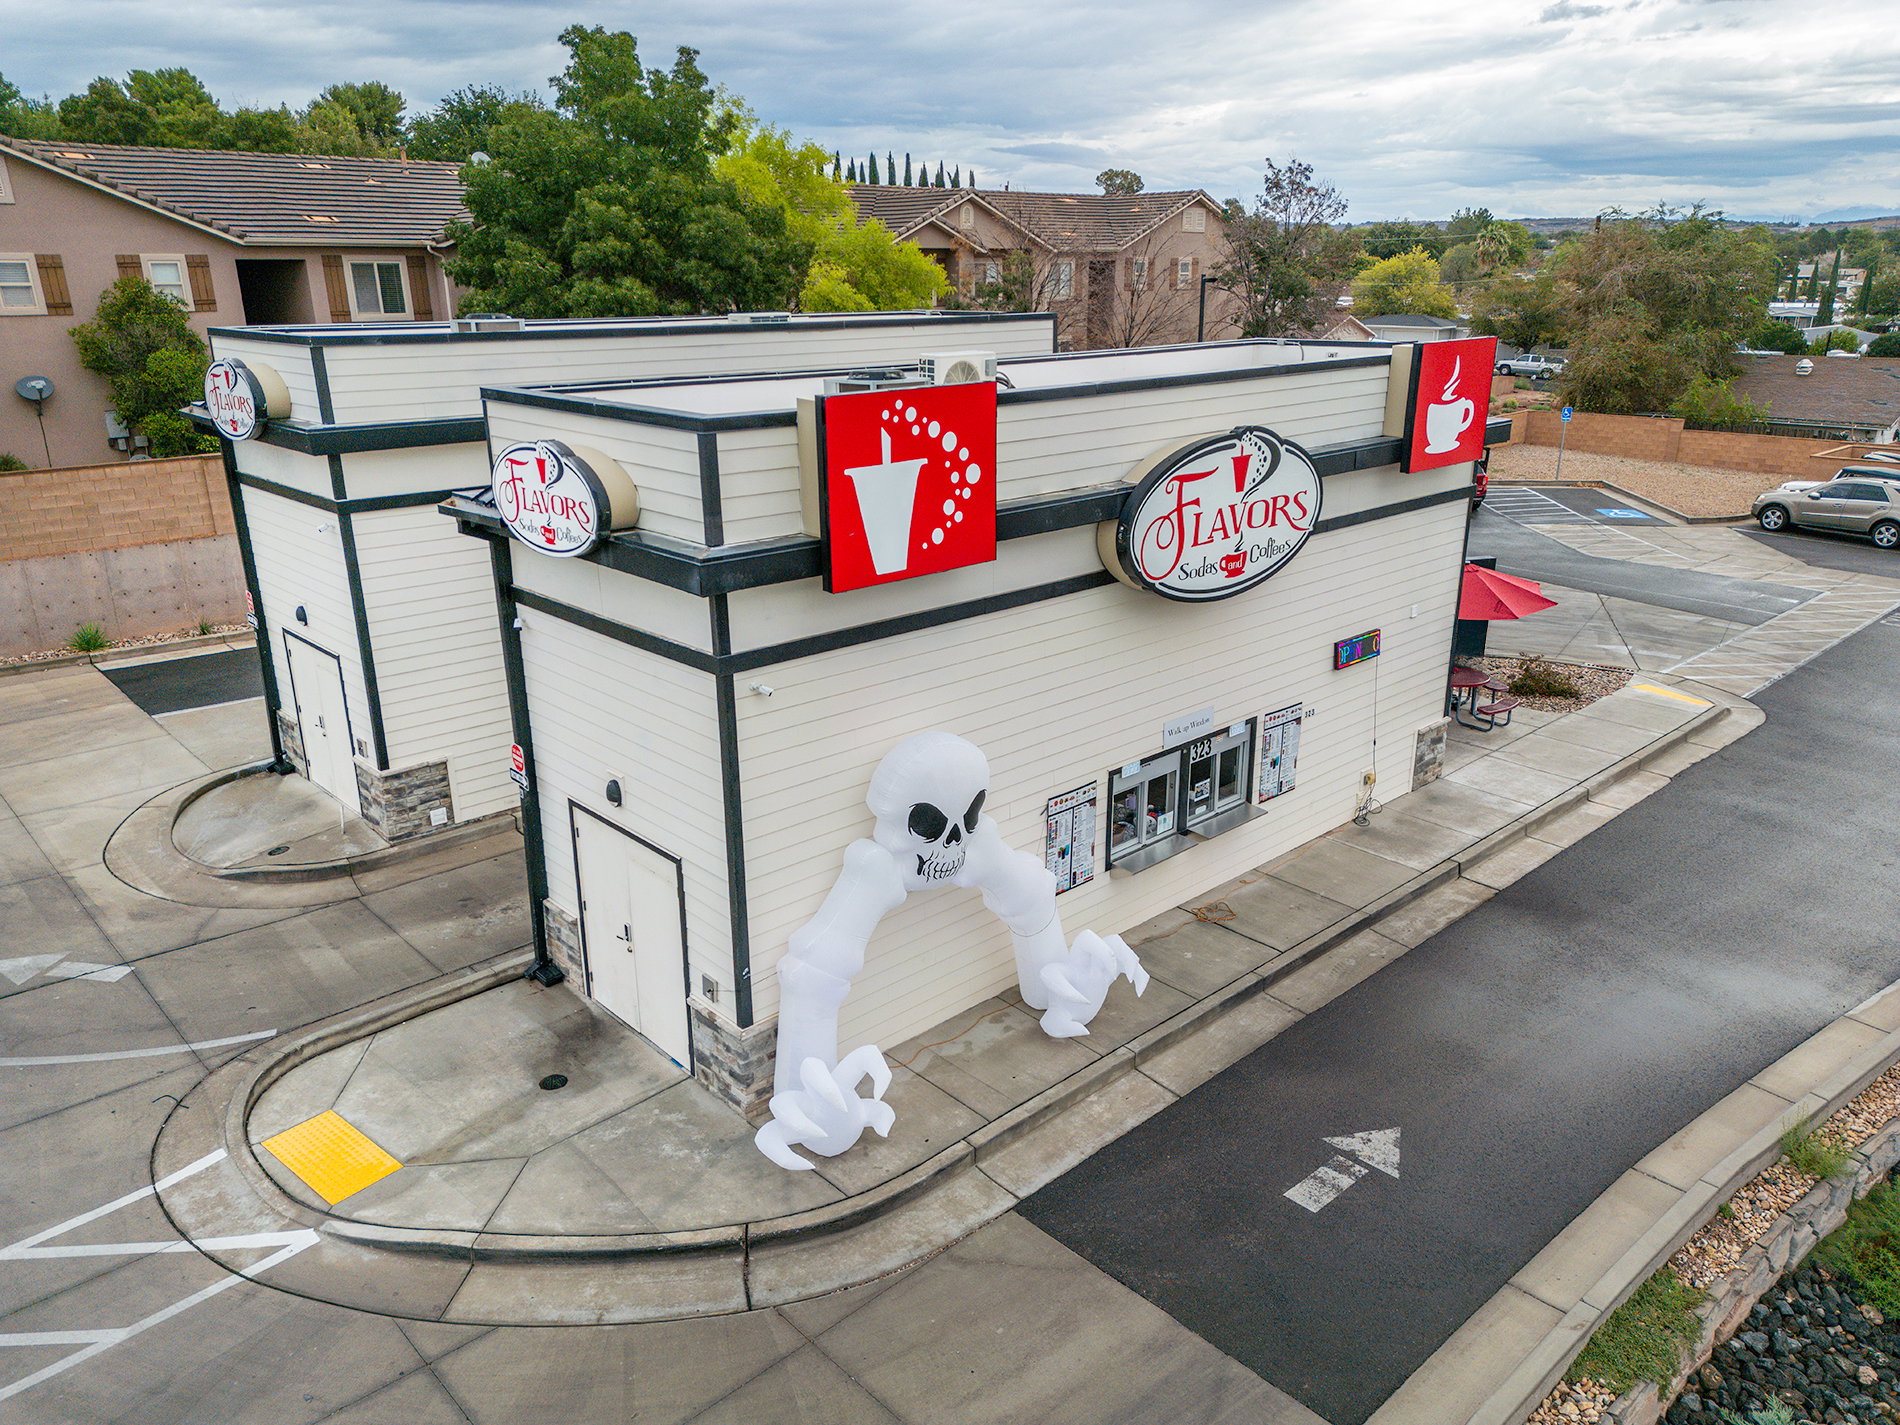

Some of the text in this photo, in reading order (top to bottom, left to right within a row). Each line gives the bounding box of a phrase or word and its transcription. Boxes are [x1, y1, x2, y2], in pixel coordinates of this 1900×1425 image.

[519, 518, 540, 535] Sodas
[556, 527, 583, 544] Coffees
[1140, 466, 1310, 581] FLAVORS
[1178, 537, 1292, 581] Sodas and Coffees
[1304, 708, 1315, 719] 323
[1191, 738, 1212, 762] 323
